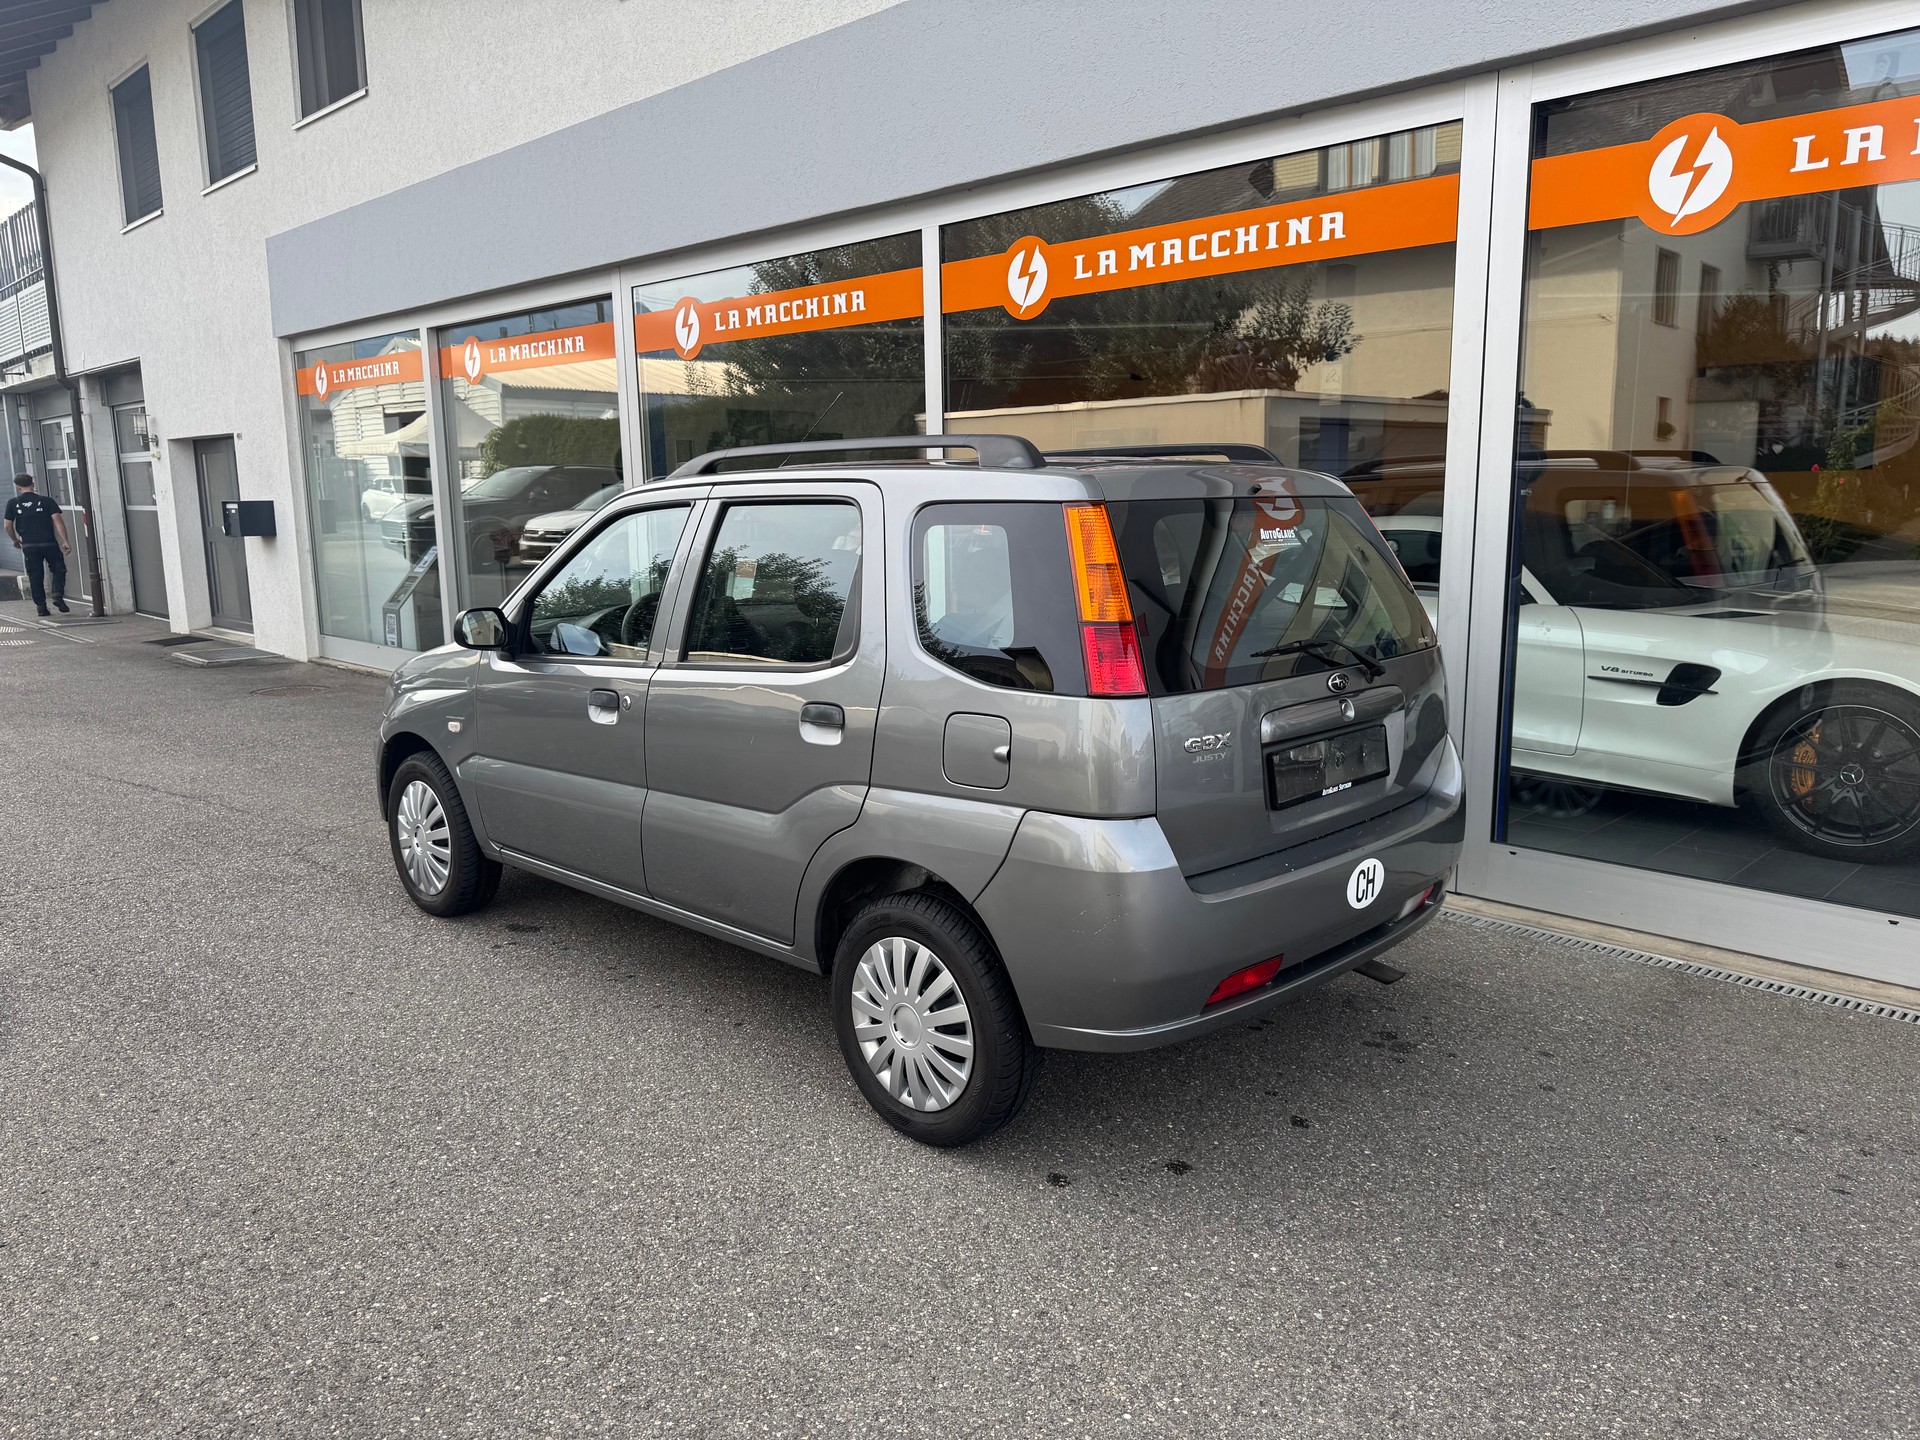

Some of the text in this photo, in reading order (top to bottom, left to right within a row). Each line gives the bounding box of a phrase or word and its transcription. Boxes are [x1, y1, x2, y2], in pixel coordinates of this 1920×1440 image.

[1789, 124, 1887, 173] LA
[1073, 211, 1346, 280] LA MACCHINA
[714, 290, 867, 332] LA MACCHINA
[489, 335, 585, 364] LA MACCHINA
[333, 361, 400, 384] LA MACCHINA
[1601, 665, 1654, 677] V8 BITURBO
[1184, 731, 1232, 753] G3X
[1192, 751, 1227, 764] JUSTY
[1355, 863, 1377, 903] CH
